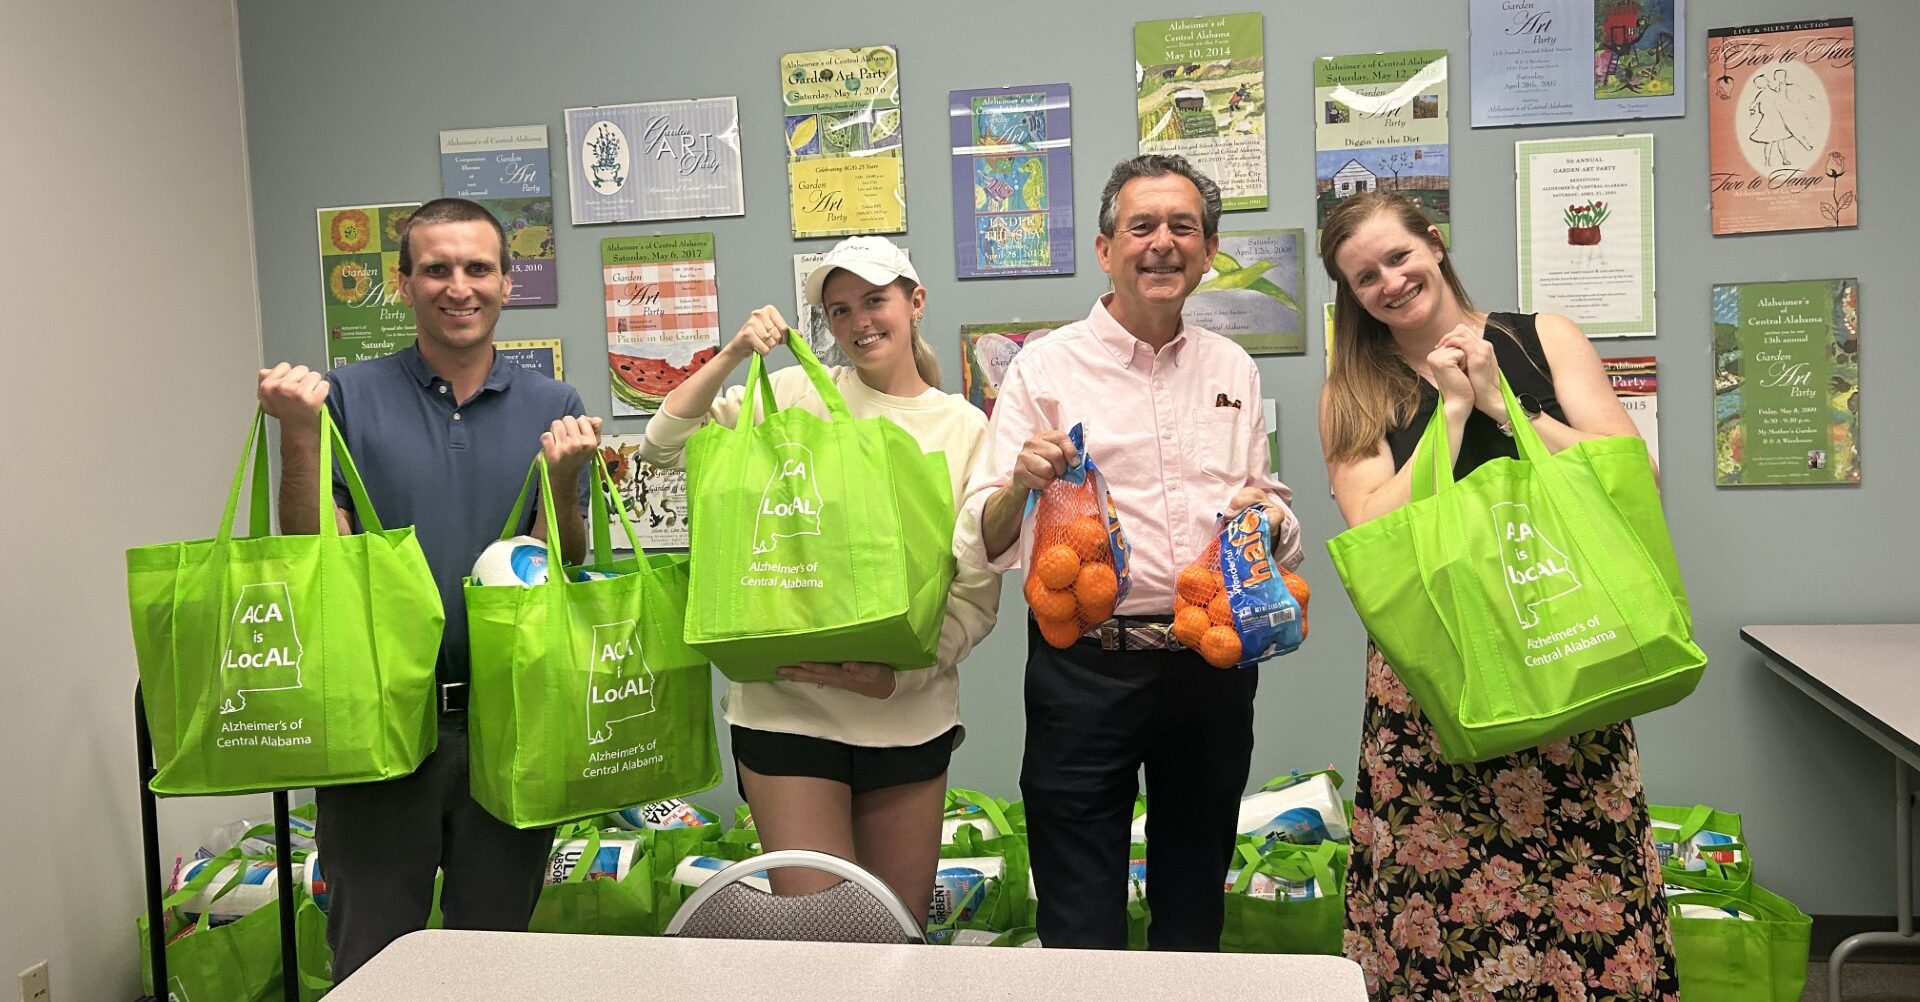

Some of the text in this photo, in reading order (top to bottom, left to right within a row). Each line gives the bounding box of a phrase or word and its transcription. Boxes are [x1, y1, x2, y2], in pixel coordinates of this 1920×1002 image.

[1502, 0, 1534, 11] Garden
[1168, 18, 1225, 31] Alzheimer's of
[1504, 10, 1552, 36] Art
[1733, 27, 1752, 36] LIVE
[1762, 24, 1790, 33] SILENT
[1793, 21, 1830, 30] AUCTION
[1165, 31, 1230, 42] Central Alabama
[1533, 35, 1557, 45] Party
[1165, 47, 1230, 61] May 10, 2014
[1726, 43, 1797, 70] Two to
[786, 54, 889, 69] Alzheimer's of Central Alabama
[1322, 58, 1406, 72] Alzheimer's of Central
[788, 68, 888, 86] Garden Art Party
[1326, 69, 1410, 83] Saturday, May 12,
[1356, 86, 1386, 97] Garden
[1504, 81, 1520, 90] April
[793, 90, 831, 101] Saturday,
[834, 90, 850, 99] May
[854, 88, 861, 96] 7,
[1025, 94, 1033, 102] of
[1359, 100, 1402, 120] Art
[1549, 101, 1573, 109] Alabama
[1384, 119, 1406, 127] Party
[643, 115, 691, 154] Garden
[1344, 137, 1375, 147] Diggin'
[1388, 136, 1401, 144] the
[1403, 135, 1419, 144] Dirt
[656, 133, 713, 160] ART
[496, 153, 521, 162] Garden
[679, 151, 720, 176] Party
[500, 162, 536, 184] Art
[815, 166, 842, 174] Celebrating
[798, 179, 827, 190] Garden
[1711, 168, 1824, 194] Two to Tango
[522, 184, 540, 193] Party
[802, 190, 843, 213] Art
[827, 212, 848, 222] Party
[1015, 229, 1040, 240] SEA
[607, 239, 707, 252] Alzheimer's of Central Alabama
[1248, 238, 1280, 247] Saturday,
[612, 249, 702, 262] Saturday, May 6, 2017
[1235, 248, 1252, 257] April
[342, 263, 378, 277] Garden
[524, 264, 542, 272] 2010
[612, 271, 642, 282] Garden
[347, 278, 400, 308] Art
[617, 283, 660, 306] Art
[1757, 297, 1810, 308] Alzheimer's
[380, 309, 406, 321] Party
[643, 306, 665, 317] Party
[1748, 315, 1823, 326] Central Alabama
[617, 330, 710, 343] Picnic in the Garden
[1763, 335, 1808, 344] 13th annual
[362, 340, 395, 350] Saturday
[356, 353, 372, 361] May
[526, 351, 534, 359] of
[1756, 350, 1791, 362] Garden
[1614, 362, 1646, 370] Alabama
[1759, 361, 1812, 388] Art
[1612, 375, 1646, 389] Party
[1790, 386, 1816, 398] Party
[778, 458, 806, 480] CA
[1506, 522, 1534, 542] AA
[1231, 510, 1272, 588] halo
[1515, 548, 1528, 561] is
[749, 561, 818, 574] Alzheimer's of
[1225, 549, 1242, 595] Wonderful
[741, 576, 824, 589] Central Alabama
[240, 603, 283, 624] ACA
[1588, 615, 1601, 629] of
[253, 630, 264, 643] is
[1524, 630, 1617, 667] Central Alabama
[222, 718, 303, 733] Alzheimer's of
[217, 734, 312, 748] Central Alabama
[589, 739, 657, 763] Alzheimer's of
[582, 754, 663, 778] Central Alabama
[647, 798, 685, 824] TRA
[553, 852, 564, 884] ABSOR
[935, 884, 946, 924] ORBENT
